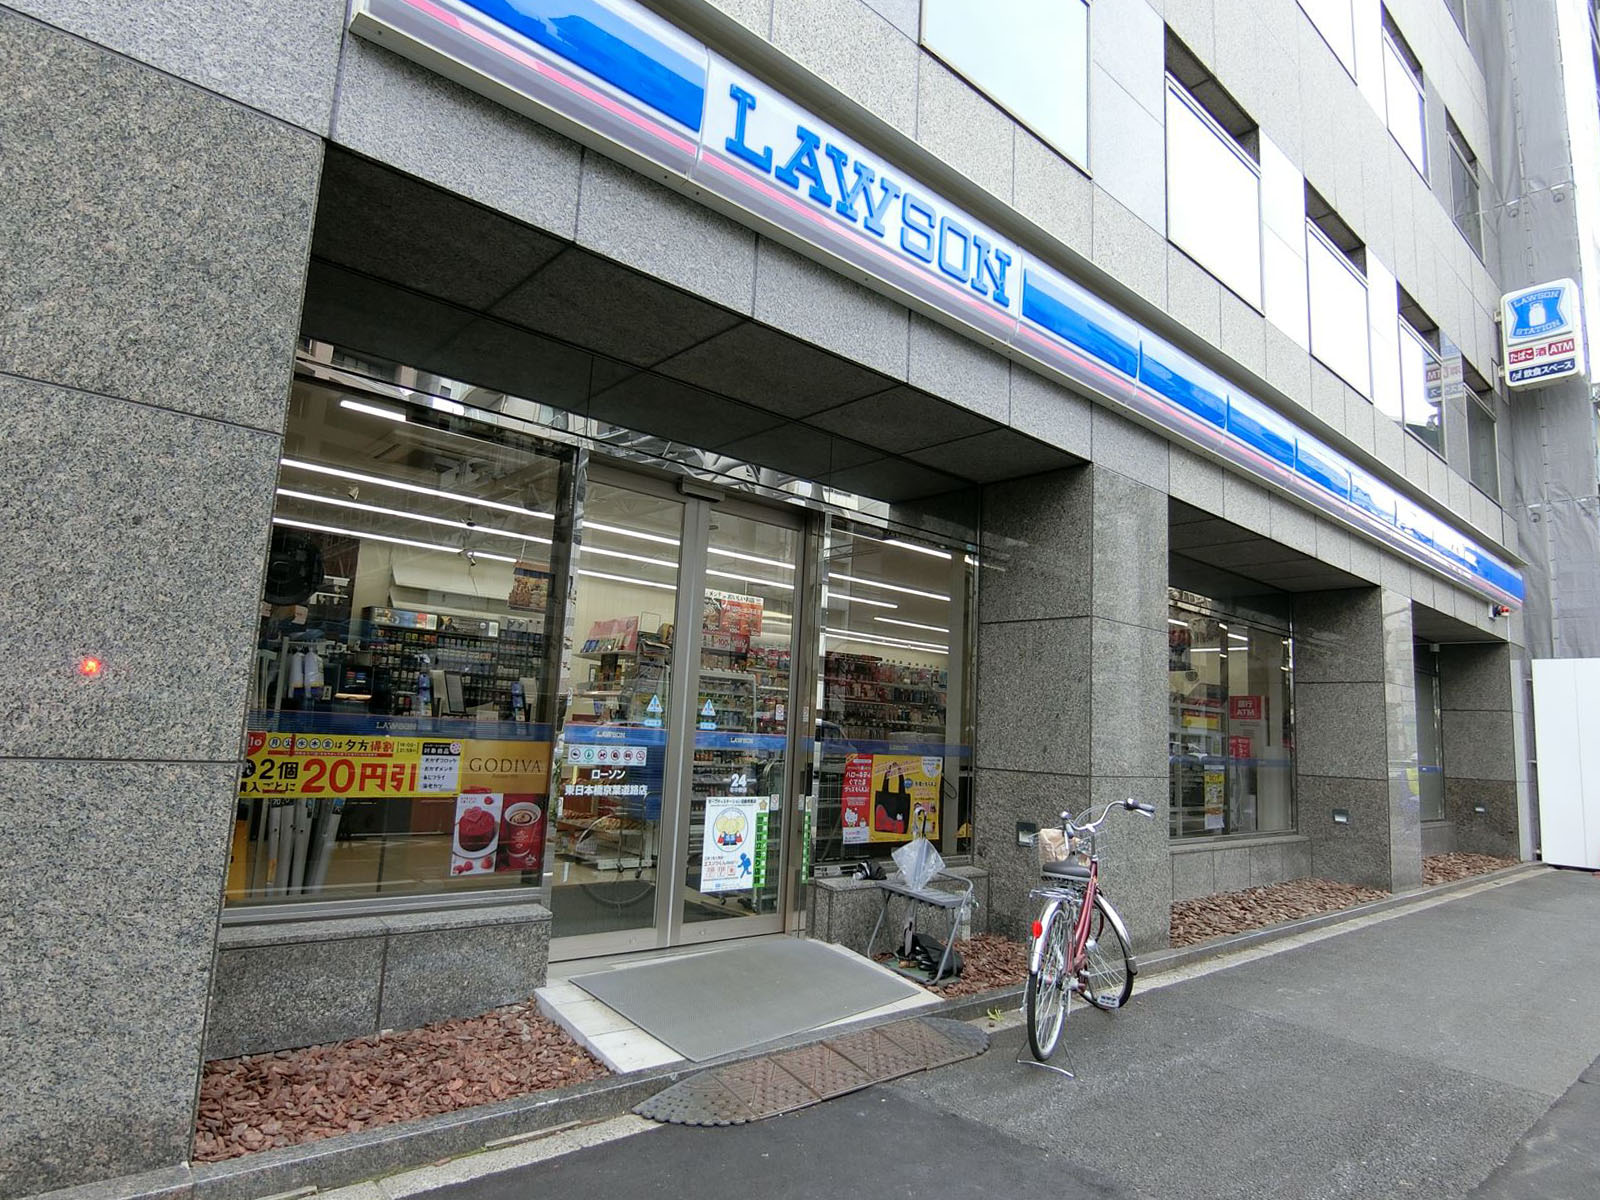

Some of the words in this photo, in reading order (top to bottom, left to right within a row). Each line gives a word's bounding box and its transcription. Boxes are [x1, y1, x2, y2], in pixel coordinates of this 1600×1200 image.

[725, 83, 1012, 308] LAWSON
[1513, 289, 1560, 307] LAWSON
[1515, 318, 1561, 336] STATION
[1510, 348, 1533, 362] たばこ
[1549, 341, 1574, 354] ATM
[1523, 361, 1573, 377] 飲食スペース
[1237, 708, 1255, 716] ATM
[469, 757, 541, 773] GODIVA
[301, 759, 417, 793] 20円引
[591, 769, 626, 779] ローソン
[731, 774, 747, 787] 24
